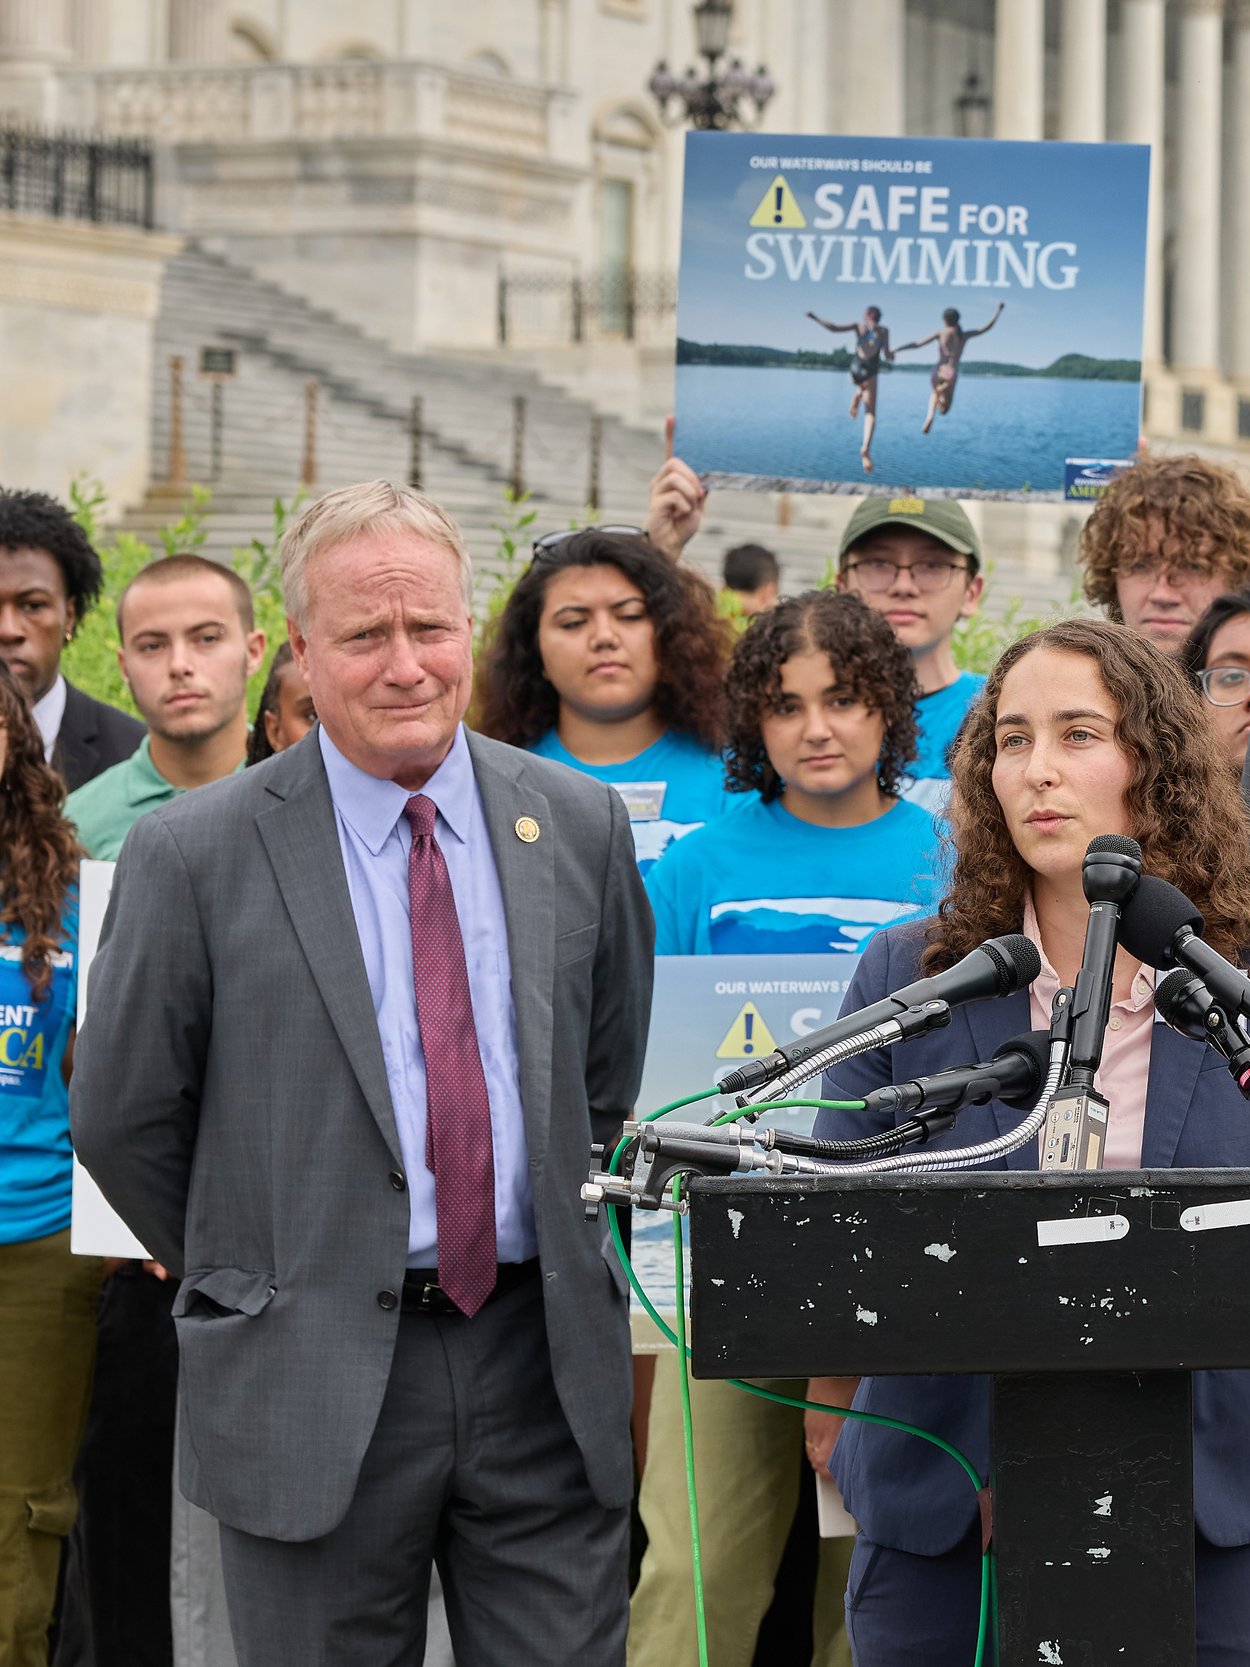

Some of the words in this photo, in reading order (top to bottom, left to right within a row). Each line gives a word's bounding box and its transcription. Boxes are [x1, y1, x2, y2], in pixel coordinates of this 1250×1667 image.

[750, 156, 779, 169] OUR
[779, 157, 860, 172] WATERWAYS
[861, 160, 914, 173] SHOULD
[915, 161, 932, 174] BE
[814, 183, 950, 233] SAFE
[959, 204, 1029, 236] FOR
[744, 232, 1080, 290] SWIMMING
[715, 982, 746, 995] OUR
[750, 981, 839, 994] WATERWAYS
